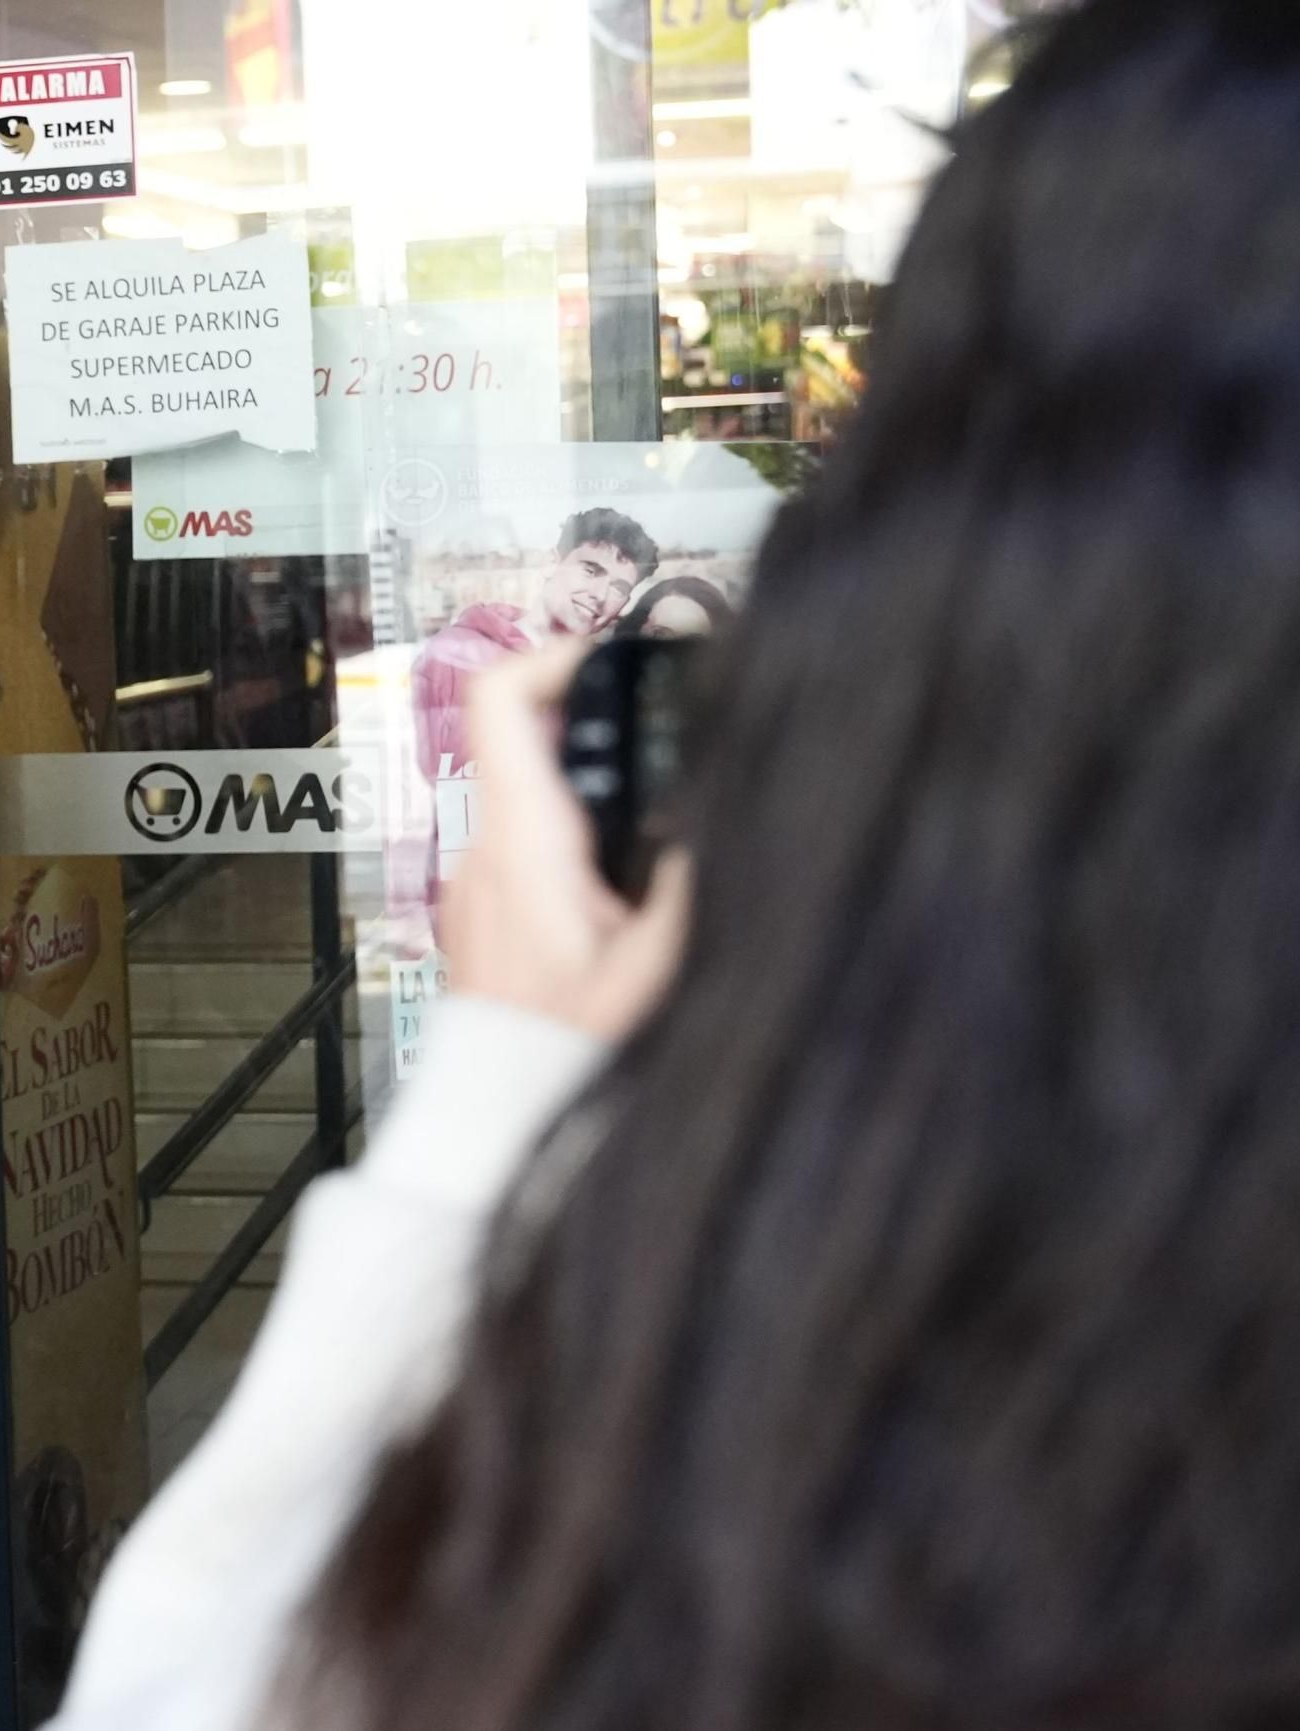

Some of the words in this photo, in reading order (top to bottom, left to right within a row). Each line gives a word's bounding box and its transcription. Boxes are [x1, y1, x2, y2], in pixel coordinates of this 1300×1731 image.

[0, 70, 105, 103] ALARMA
[44, 119, 114, 139] EIMEN
[53, 138, 106, 149] SISTEMAS
[20, 174, 61, 194] 250
[66, 172, 93, 190] 09
[99, 169, 126, 188] 63
[51, 282, 77, 302] SE
[84, 275, 185, 301] ALQUILA
[193, 269, 266, 293] PLAZA
[41, 321, 70, 342] DE
[78, 315, 166, 340] GARAJE
[175, 308, 279, 333] PARKING
[71, 349, 252, 379] SUPERMECADO
[70, 395, 143, 418] M.A.S.
[151, 388, 258, 414] BUHAIRA
[179, 509, 253, 538] MAS
[204, 772, 373, 834] MAS
[399, 970, 426, 1004] LA
[31, 1000, 118, 1089] SABOR
